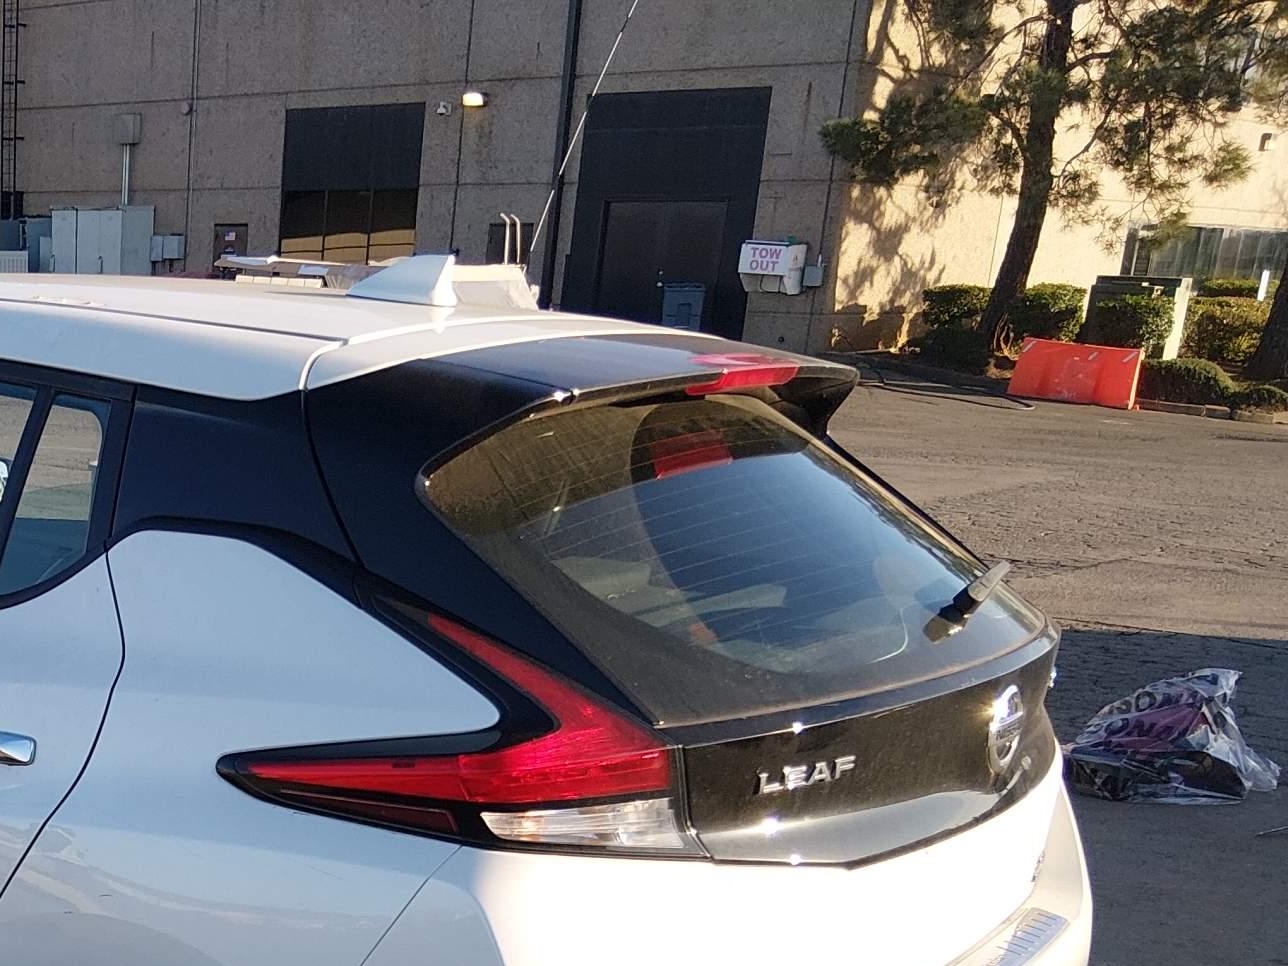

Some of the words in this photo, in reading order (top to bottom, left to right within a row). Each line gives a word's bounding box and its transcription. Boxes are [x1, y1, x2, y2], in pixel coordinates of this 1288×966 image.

[751, 248, 782, 259] TOW
[749, 260, 779, 271] OUT
[757, 755, 856, 795] LEAF
